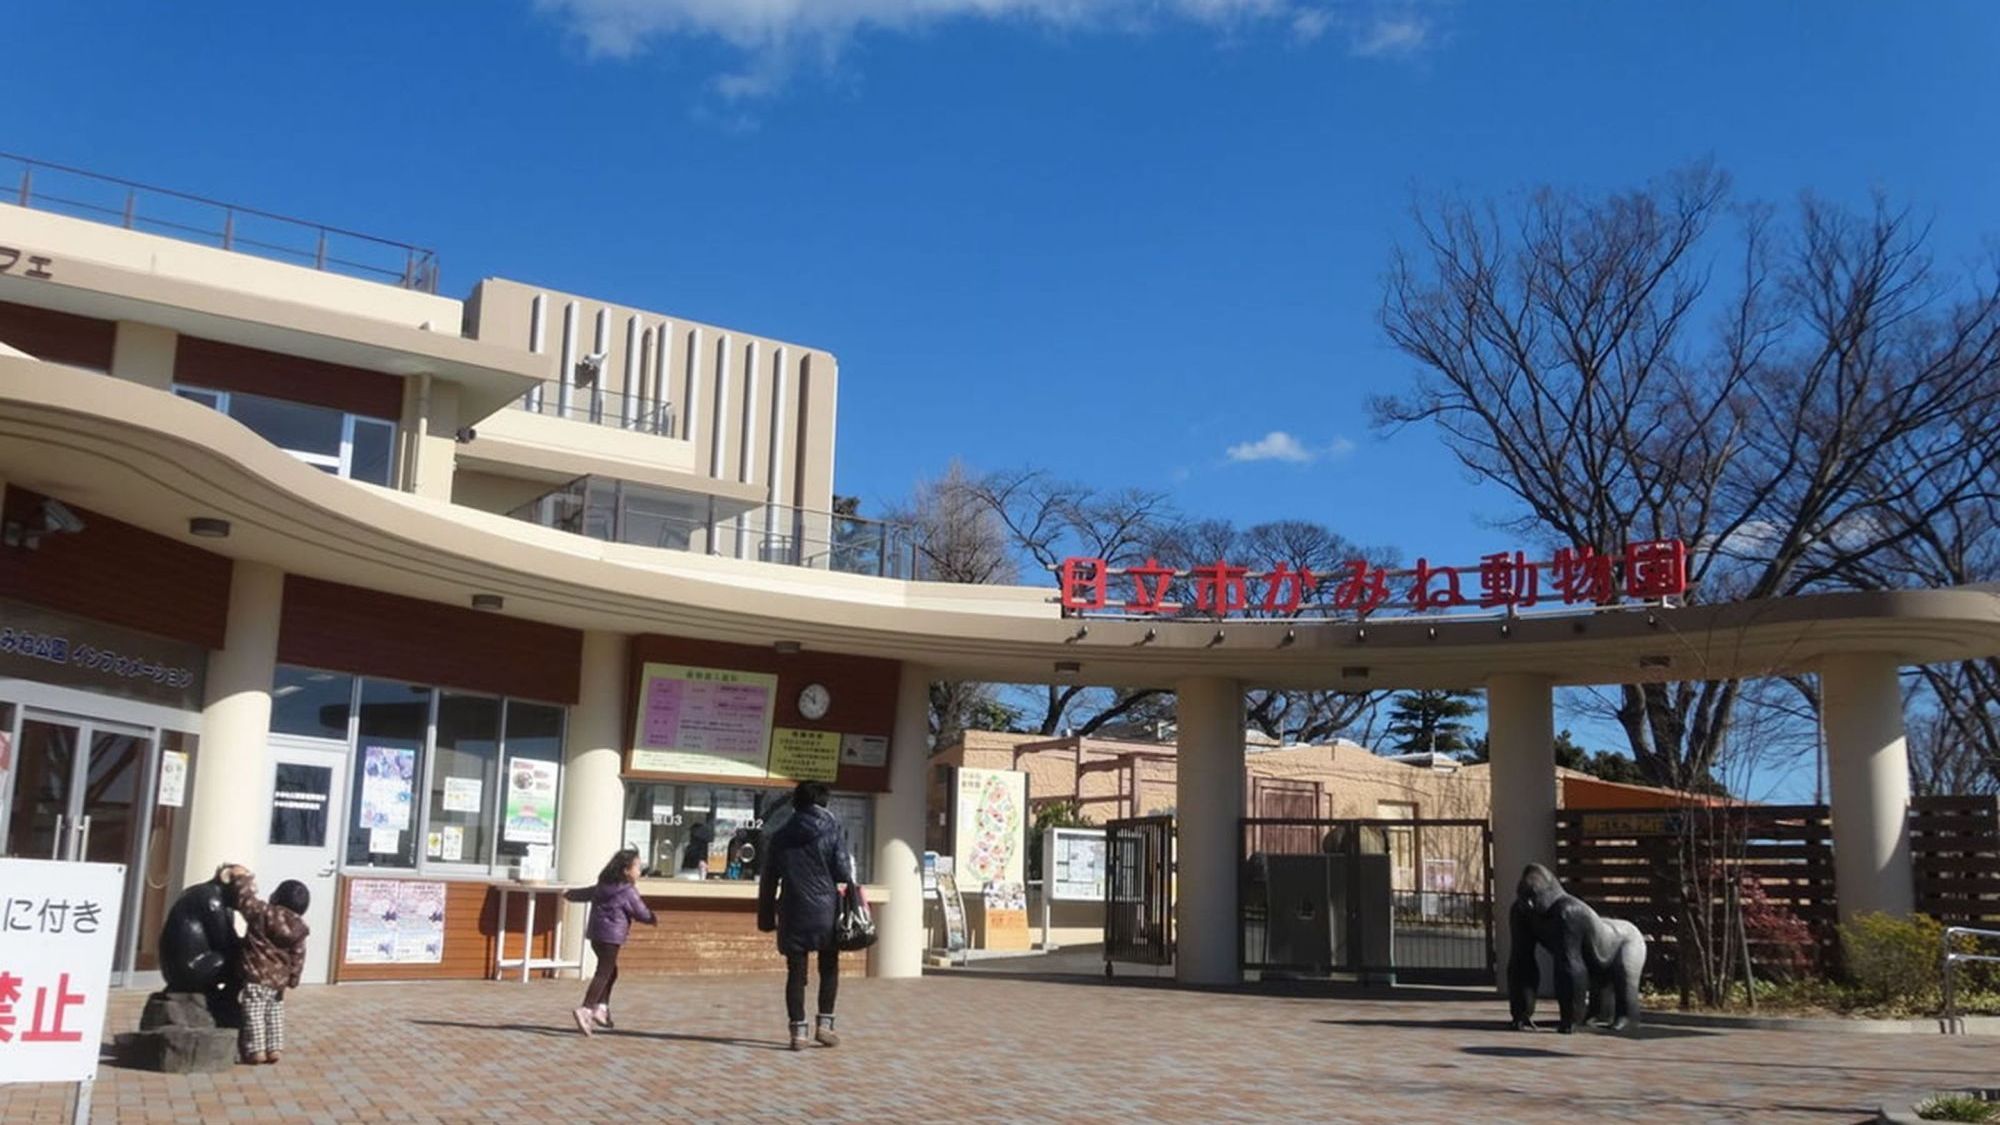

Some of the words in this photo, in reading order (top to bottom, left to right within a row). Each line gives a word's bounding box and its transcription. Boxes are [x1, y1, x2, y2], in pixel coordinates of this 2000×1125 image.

[1062, 539, 1686, 616] 日立市かみね動物園
[72, 643, 194, 689] インフォメーション
[3, 898, 102, 933] に付き
